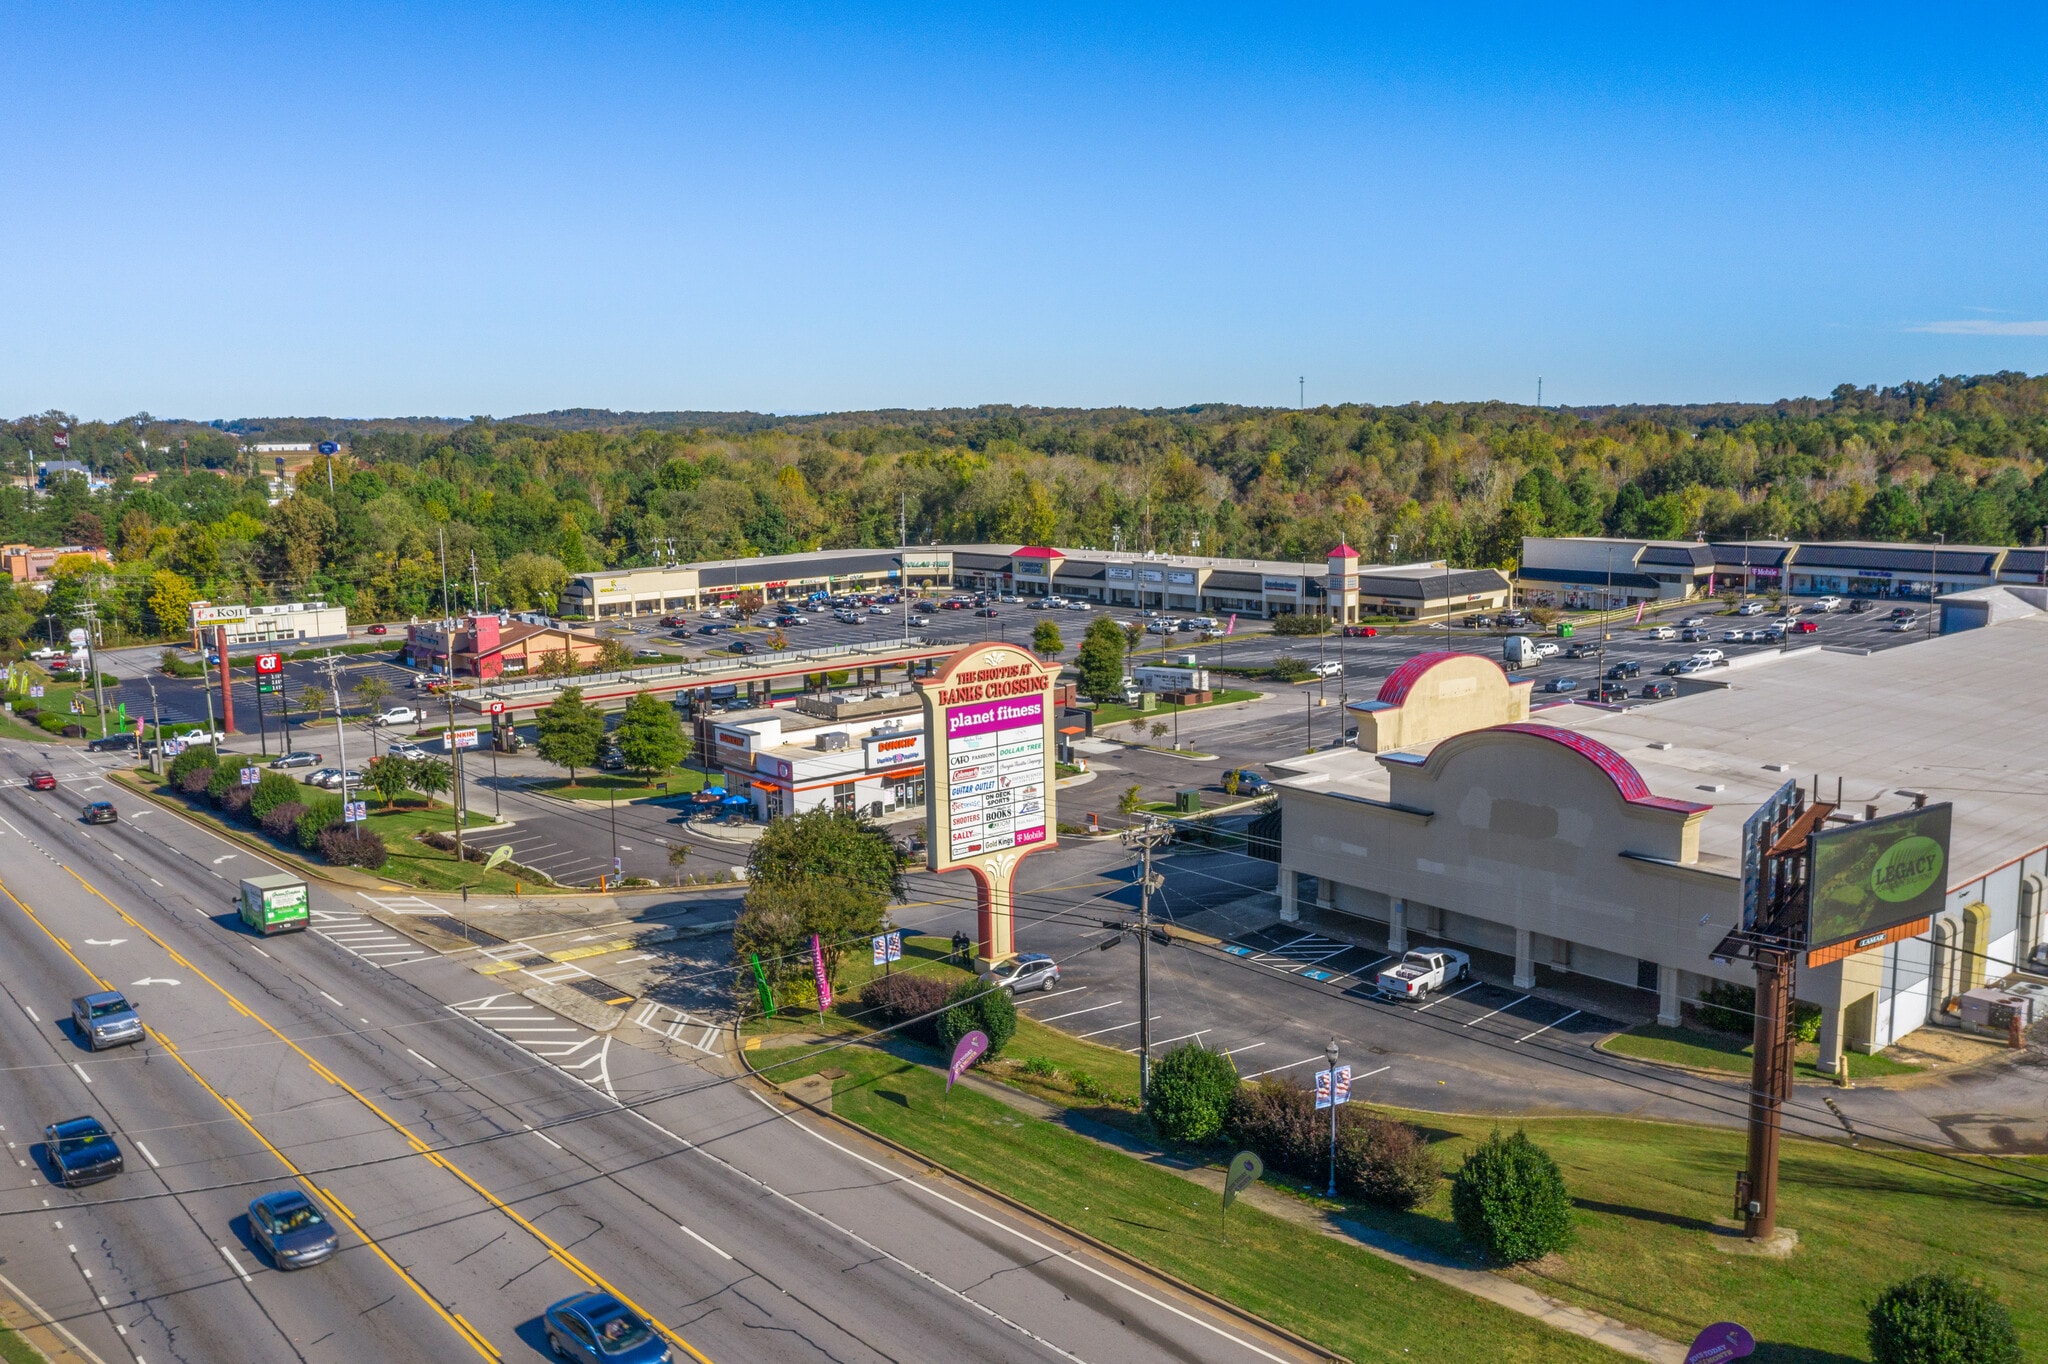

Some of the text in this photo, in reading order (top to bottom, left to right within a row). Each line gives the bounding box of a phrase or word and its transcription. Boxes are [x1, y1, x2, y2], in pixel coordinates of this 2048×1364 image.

[260, 656, 277, 670] QT
[956, 663, 1032, 685] THE SHOPPES AT
[938, 674, 1050, 706] BANKS CROSSING
[949, 703, 1041, 732] planet fitness
[999, 742, 1042, 756] DOLLAR TREE
[951, 780, 996, 796] GUITAR OUTLET
[995, 790, 1011, 799] DECK
[987, 797, 1010, 807] SPORTS
[953, 813, 980, 826] SHOOTERS
[985, 809, 1012, 821] BOOKS
[952, 830, 974, 841] SALLY
[985, 837, 1014, 849] Gold Kings
[1876, 854, 1937, 886] LEGACY
[1703, 1344, 1727, 1358] TODAY
